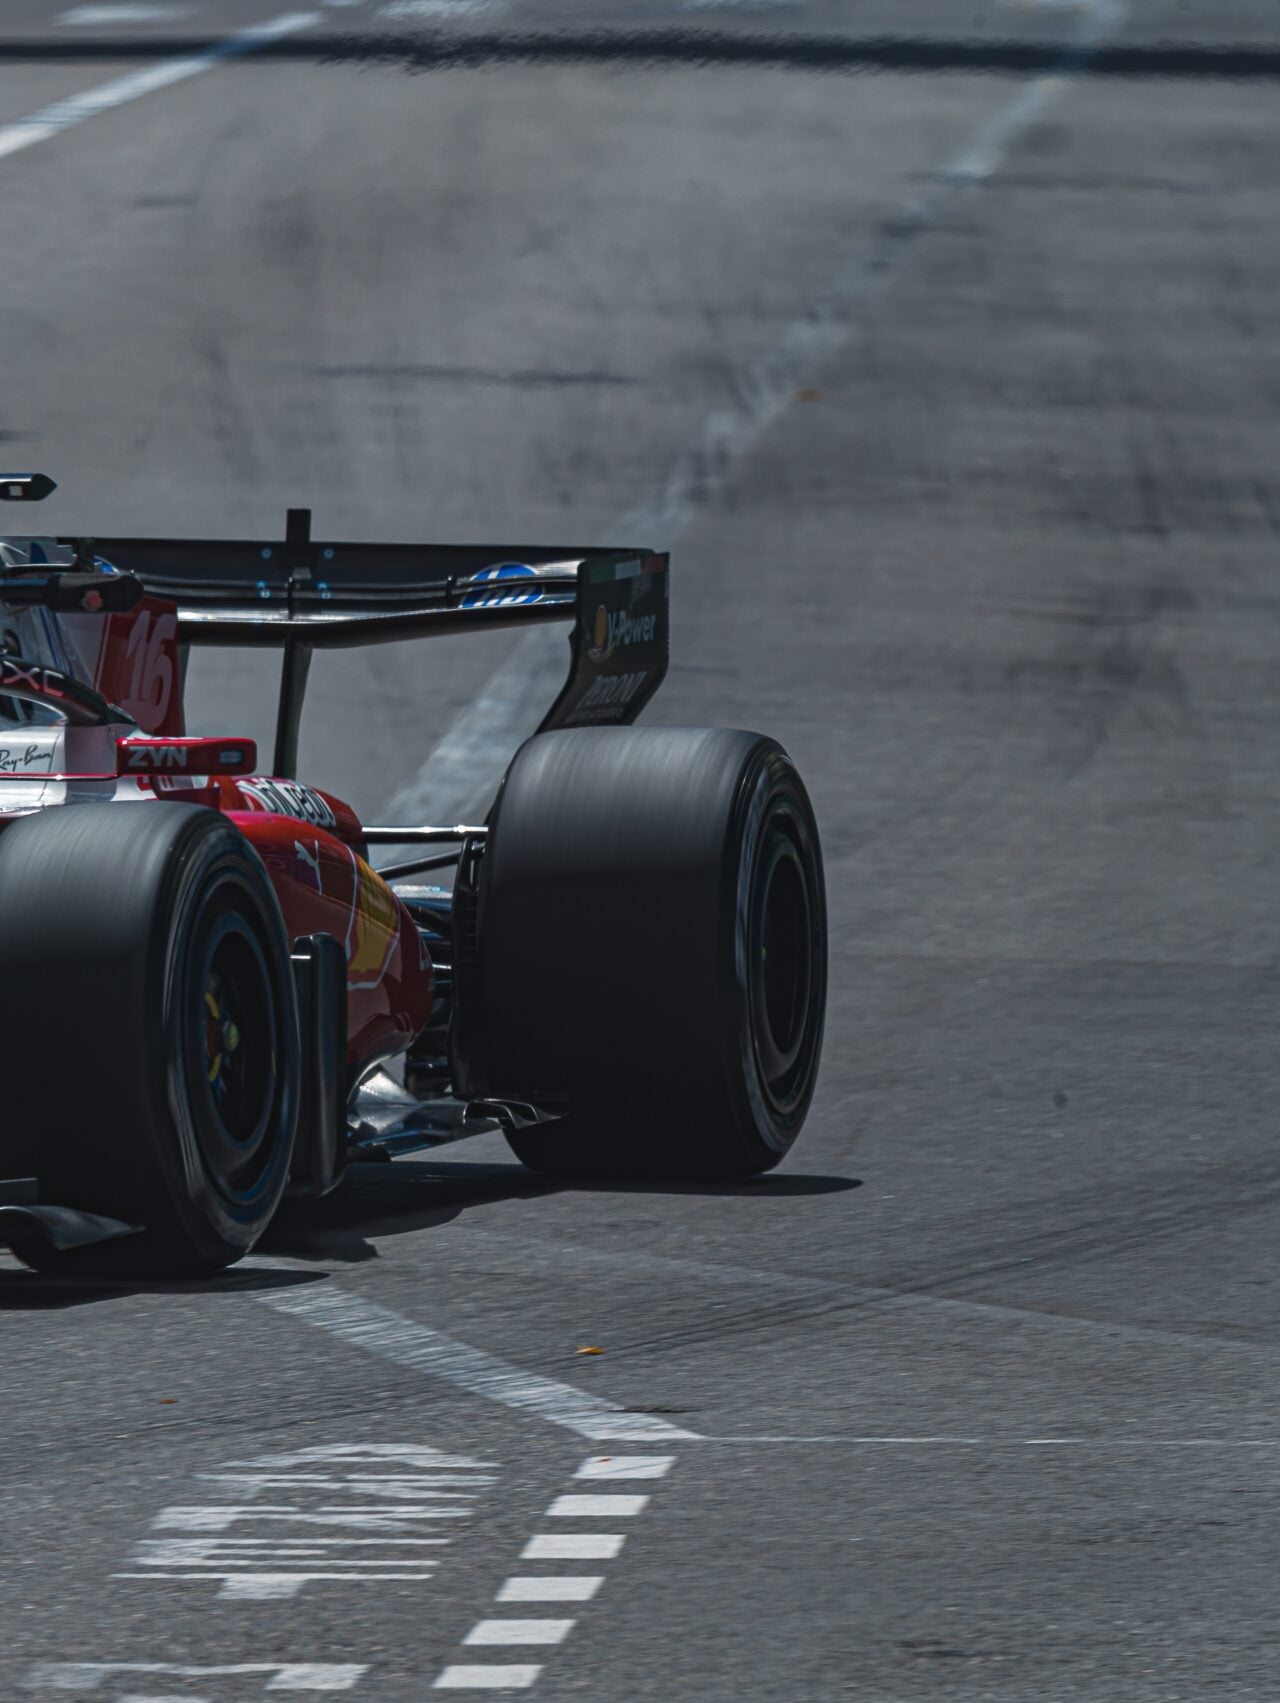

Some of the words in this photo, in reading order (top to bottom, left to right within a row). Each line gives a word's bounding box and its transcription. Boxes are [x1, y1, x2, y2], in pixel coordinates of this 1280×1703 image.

[608, 610, 657, 651] V-Power
[120, 609, 176, 731] 16
[128, 746, 188, 768] ZYN
